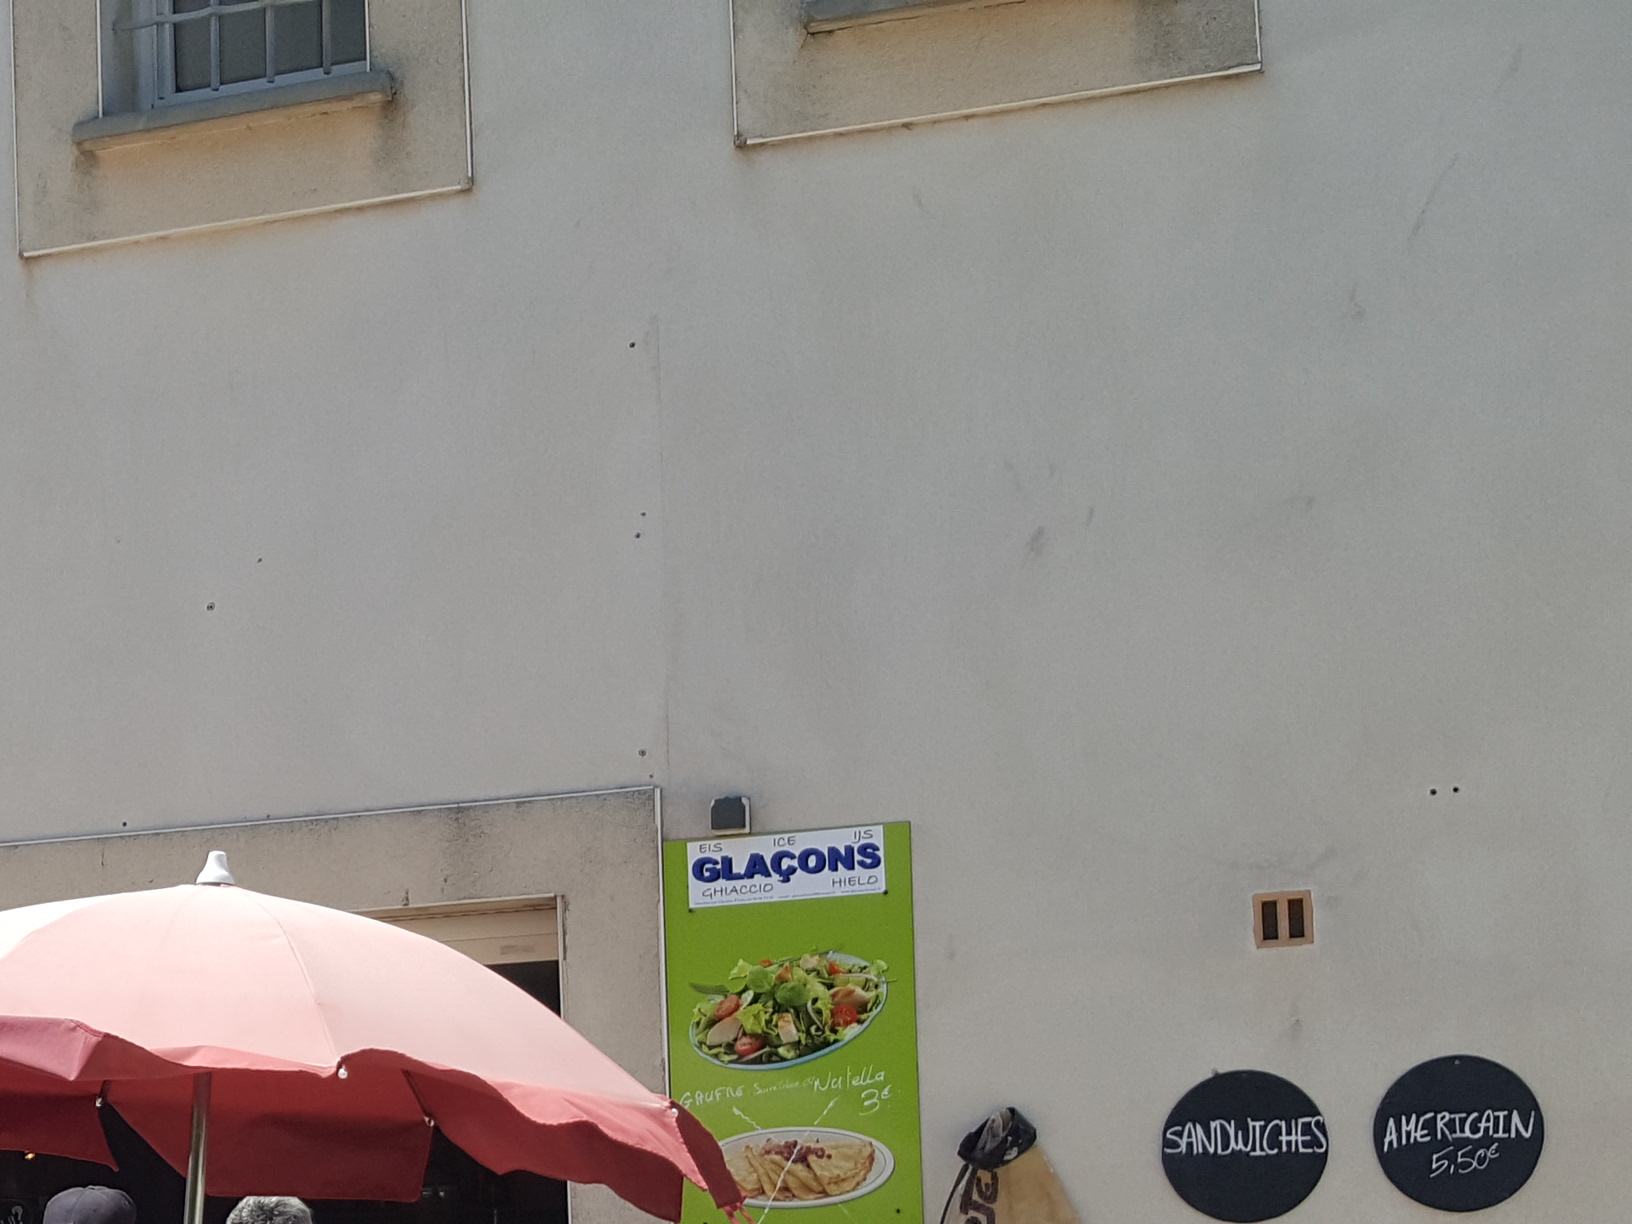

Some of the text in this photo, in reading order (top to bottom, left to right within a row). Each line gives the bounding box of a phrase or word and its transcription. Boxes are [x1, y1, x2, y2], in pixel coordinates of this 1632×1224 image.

[699, 842, 722, 854] EIS
[773, 836, 796, 848] ICE
[691, 842, 882, 884] GLAÇONS
[701, 882, 774, 899] GHIACCIO
[831, 874, 879, 888] HIELO
[679, 1085, 745, 1109] GAUFRE
[1163, 1115, 1327, 1157] SANDWICHES
[1382, 1108, 1536, 1153] AMERICAIN
